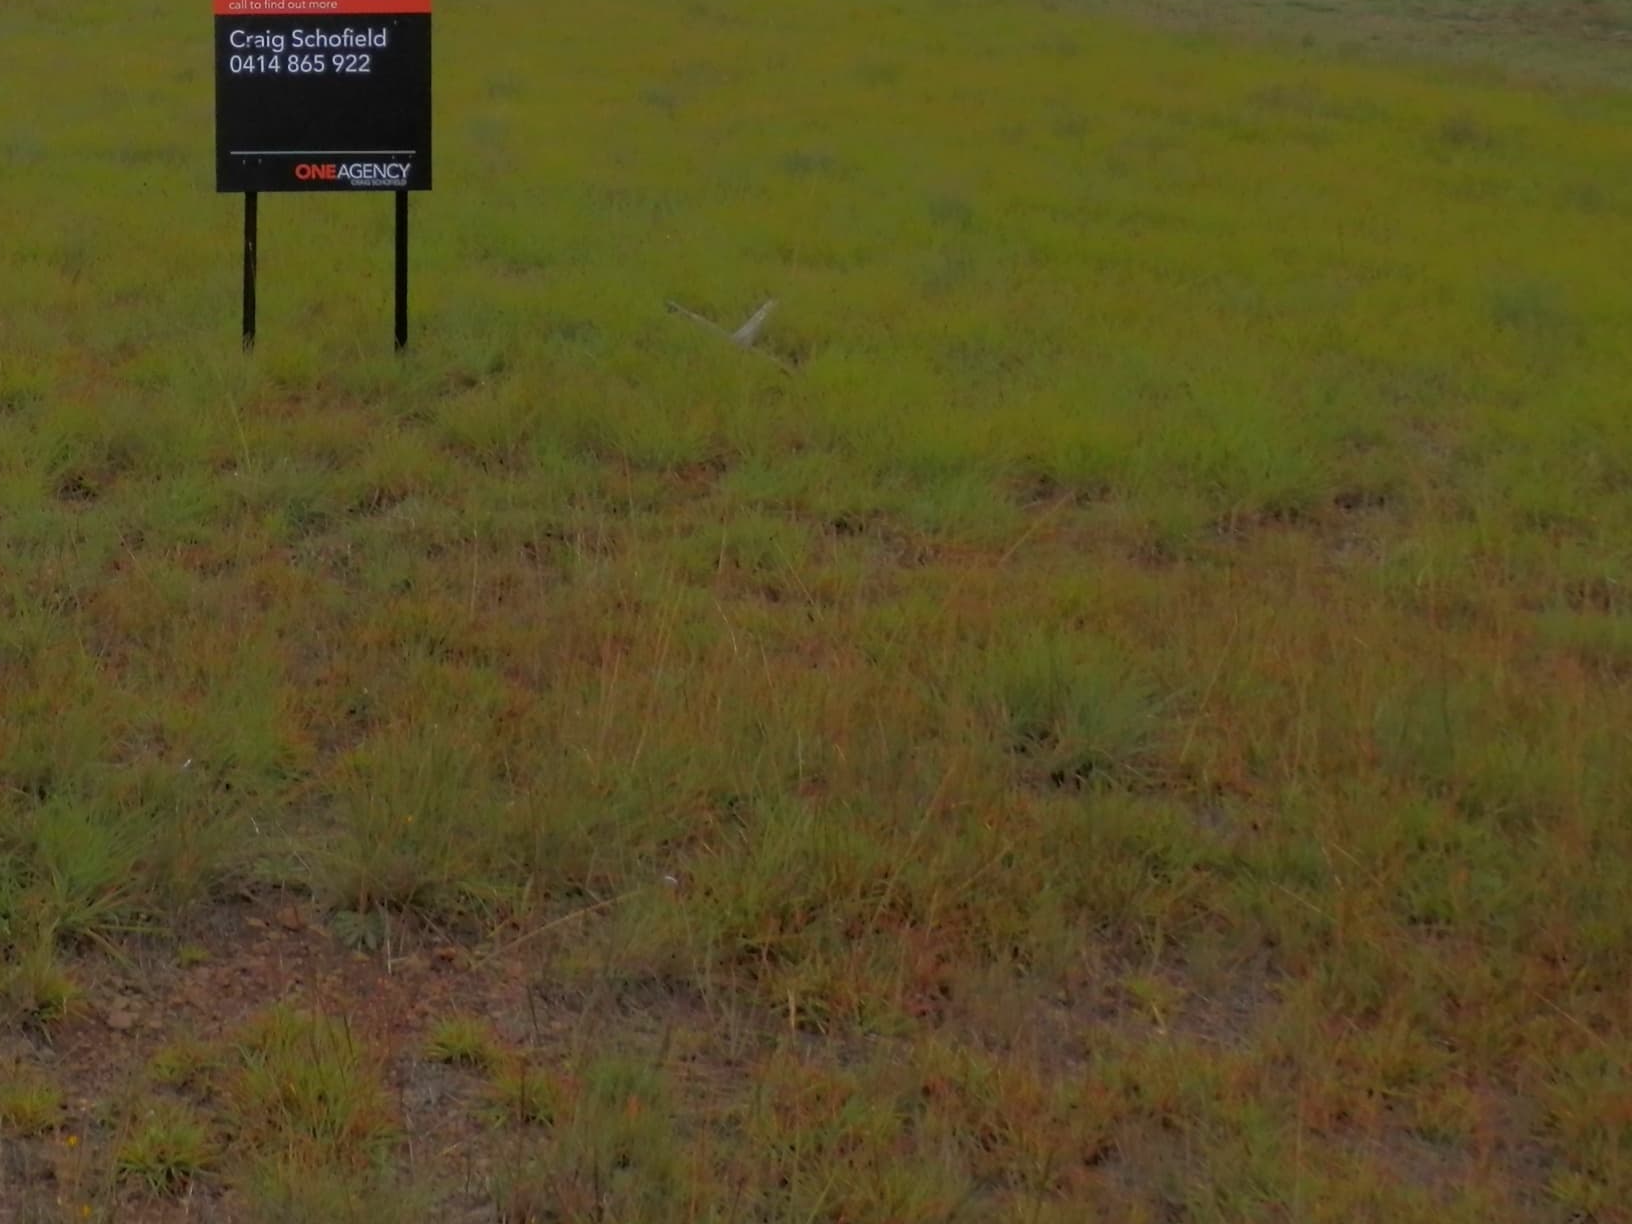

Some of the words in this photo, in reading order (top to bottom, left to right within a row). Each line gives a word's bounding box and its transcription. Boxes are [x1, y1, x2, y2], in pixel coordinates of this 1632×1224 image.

[228, 0, 247, 10] call
[250, 1, 262, 10] to
[287, 1, 306, 9] out
[308, 1, 338, 9] more
[229, 29, 285, 53] Craig
[291, 27, 387, 48] Schofield
[229, 55, 280, 73] 0414
[287, 54, 325, 73] 865
[331, 53, 370, 73] 922
